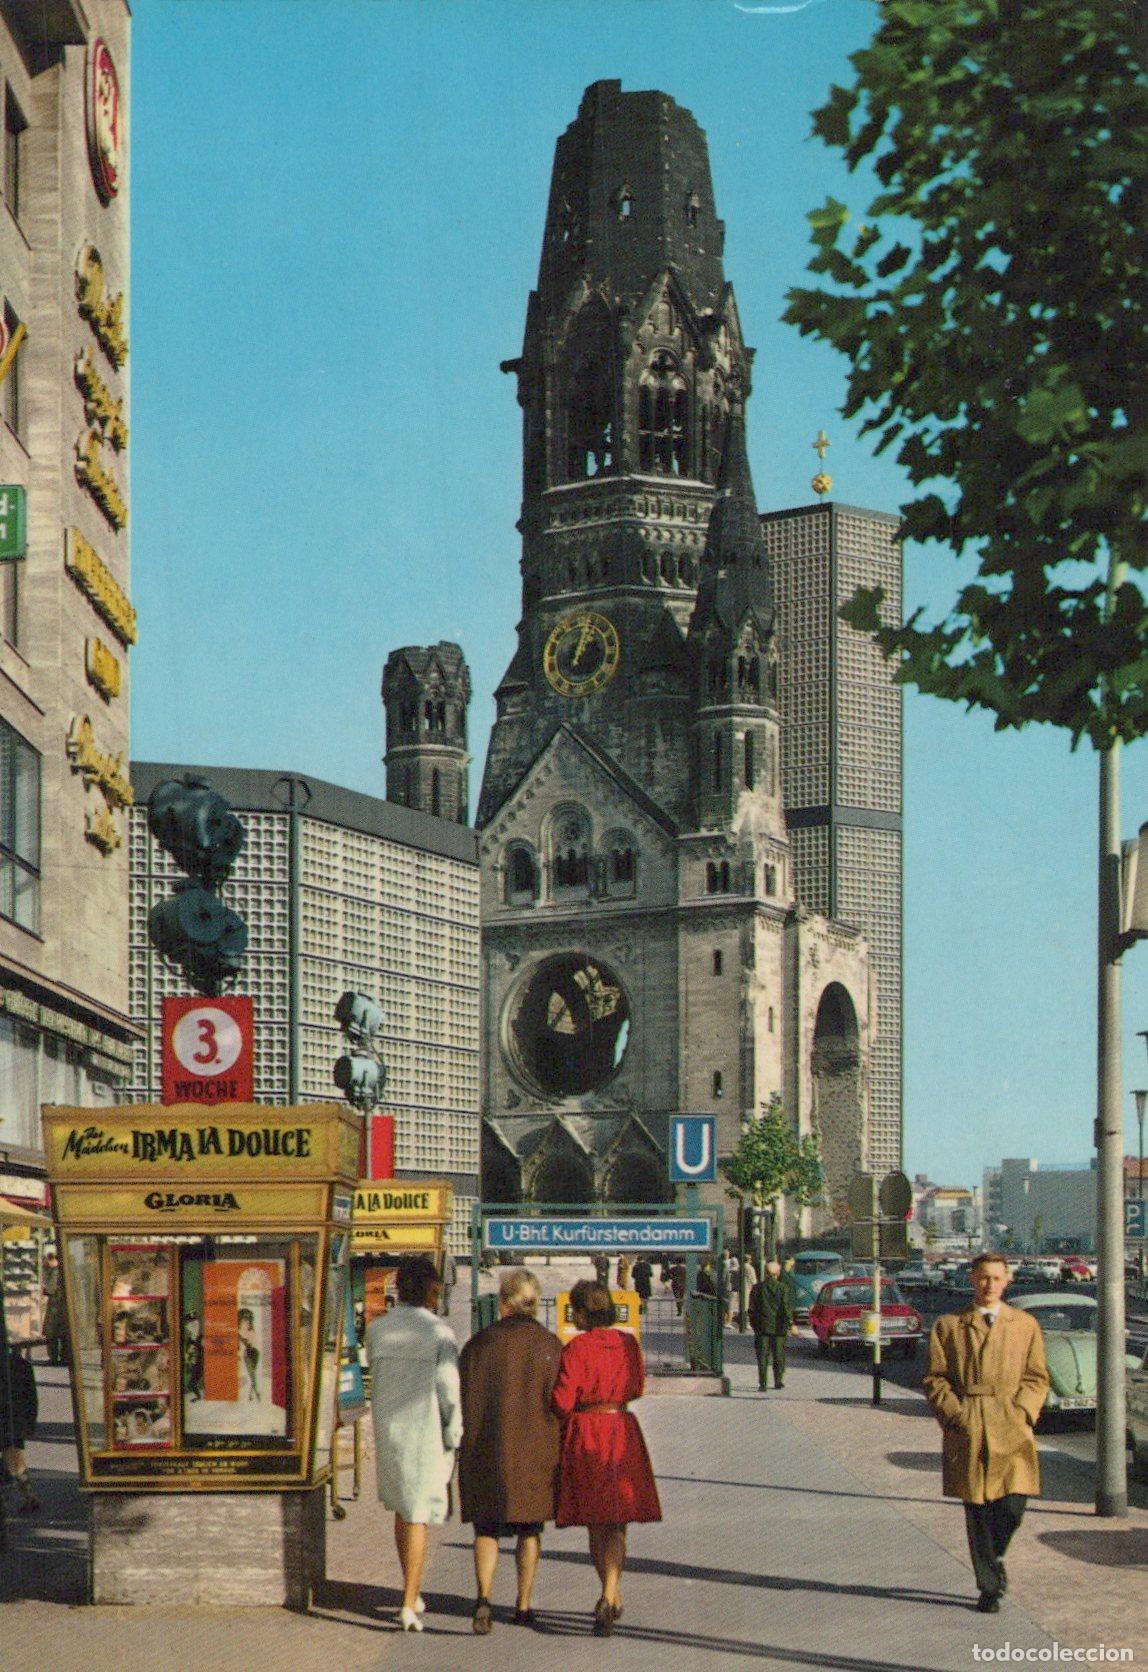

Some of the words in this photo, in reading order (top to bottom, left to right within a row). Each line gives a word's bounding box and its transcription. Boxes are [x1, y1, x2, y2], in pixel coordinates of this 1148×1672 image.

[175, 1081, 238, 1098] WOCHE
[131, 1128, 196, 1162] IRMA
[197, 1126, 223, 1155] LA
[227, 1128, 311, 1157] DOUCE
[676, 1123, 709, 1174] U
[144, 1192, 241, 1212] GLORIA
[383, 1192, 429, 1210] DOUCE
